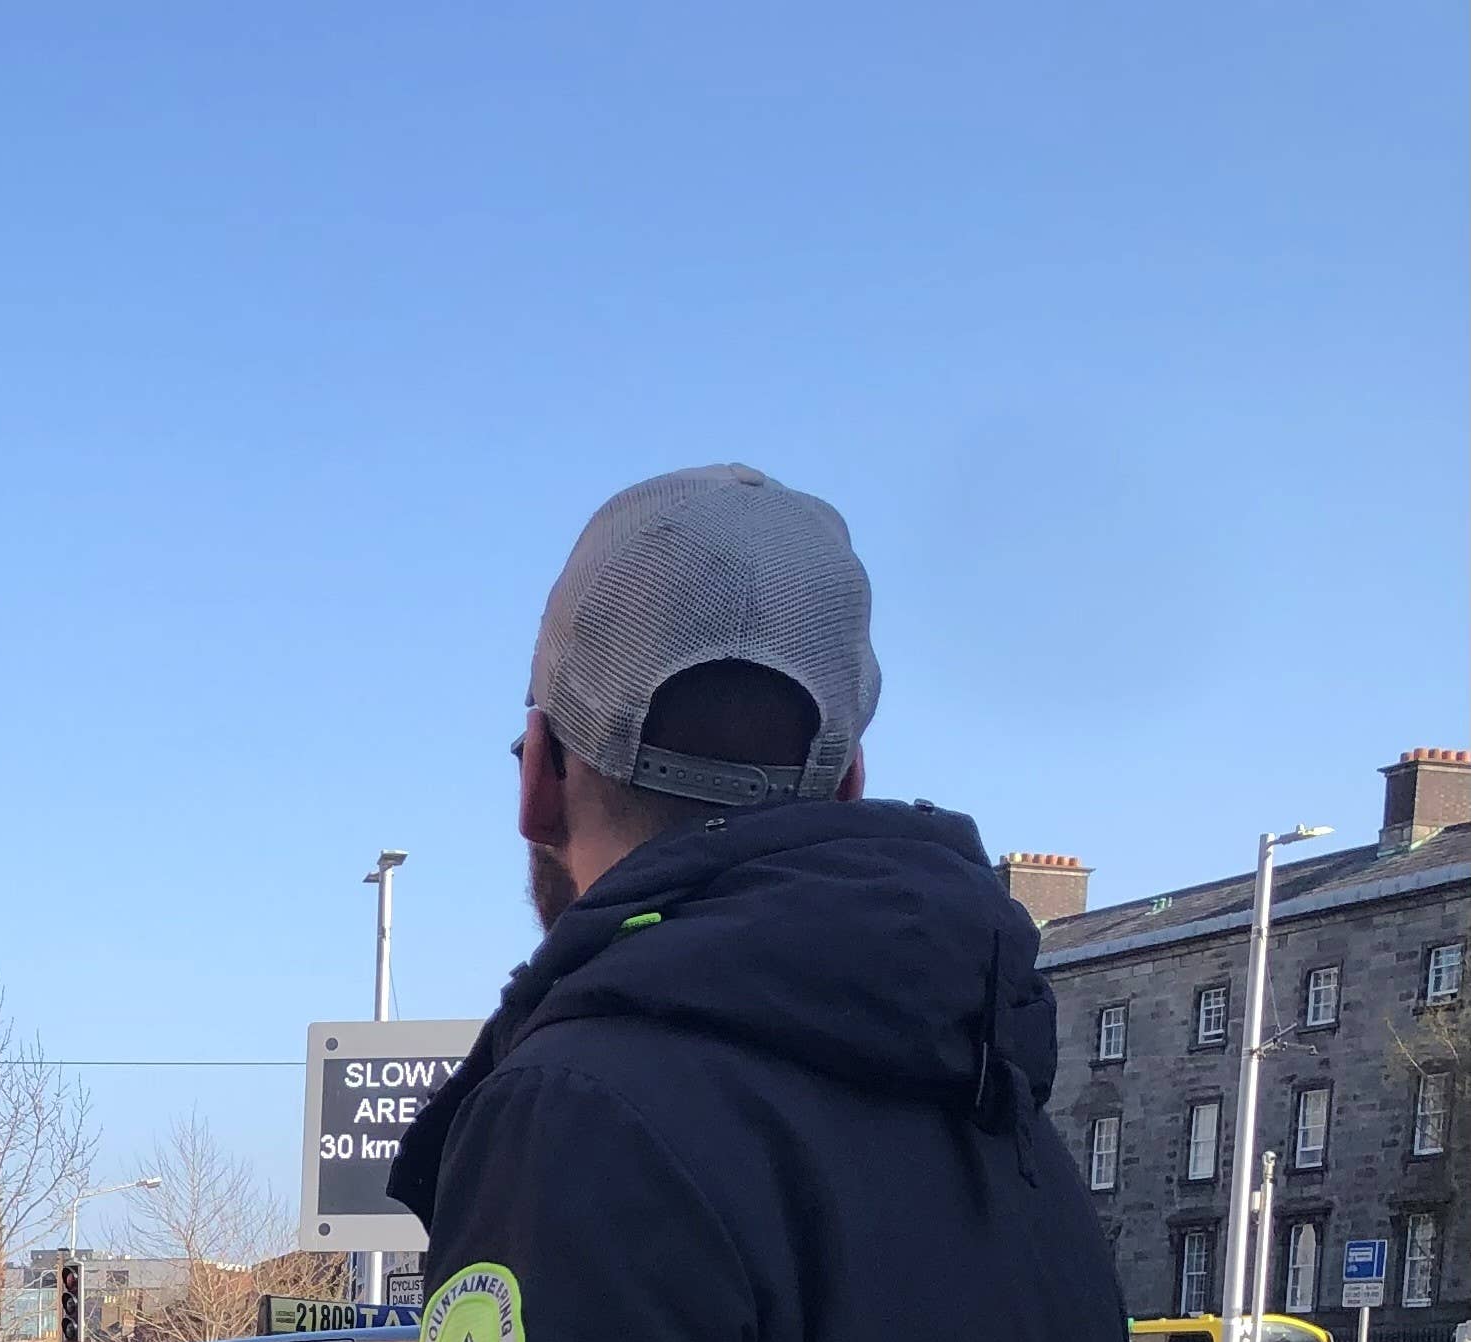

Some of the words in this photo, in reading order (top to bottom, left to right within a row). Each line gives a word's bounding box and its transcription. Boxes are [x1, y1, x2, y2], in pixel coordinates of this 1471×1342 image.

[344, 1061, 436, 1088] SLOW
[354, 1097, 417, 1123] ARE
[320, 1134, 353, 1160] 30
[392, 1295, 414, 1305] DAME
[296, 1303, 355, 1332] 21809
